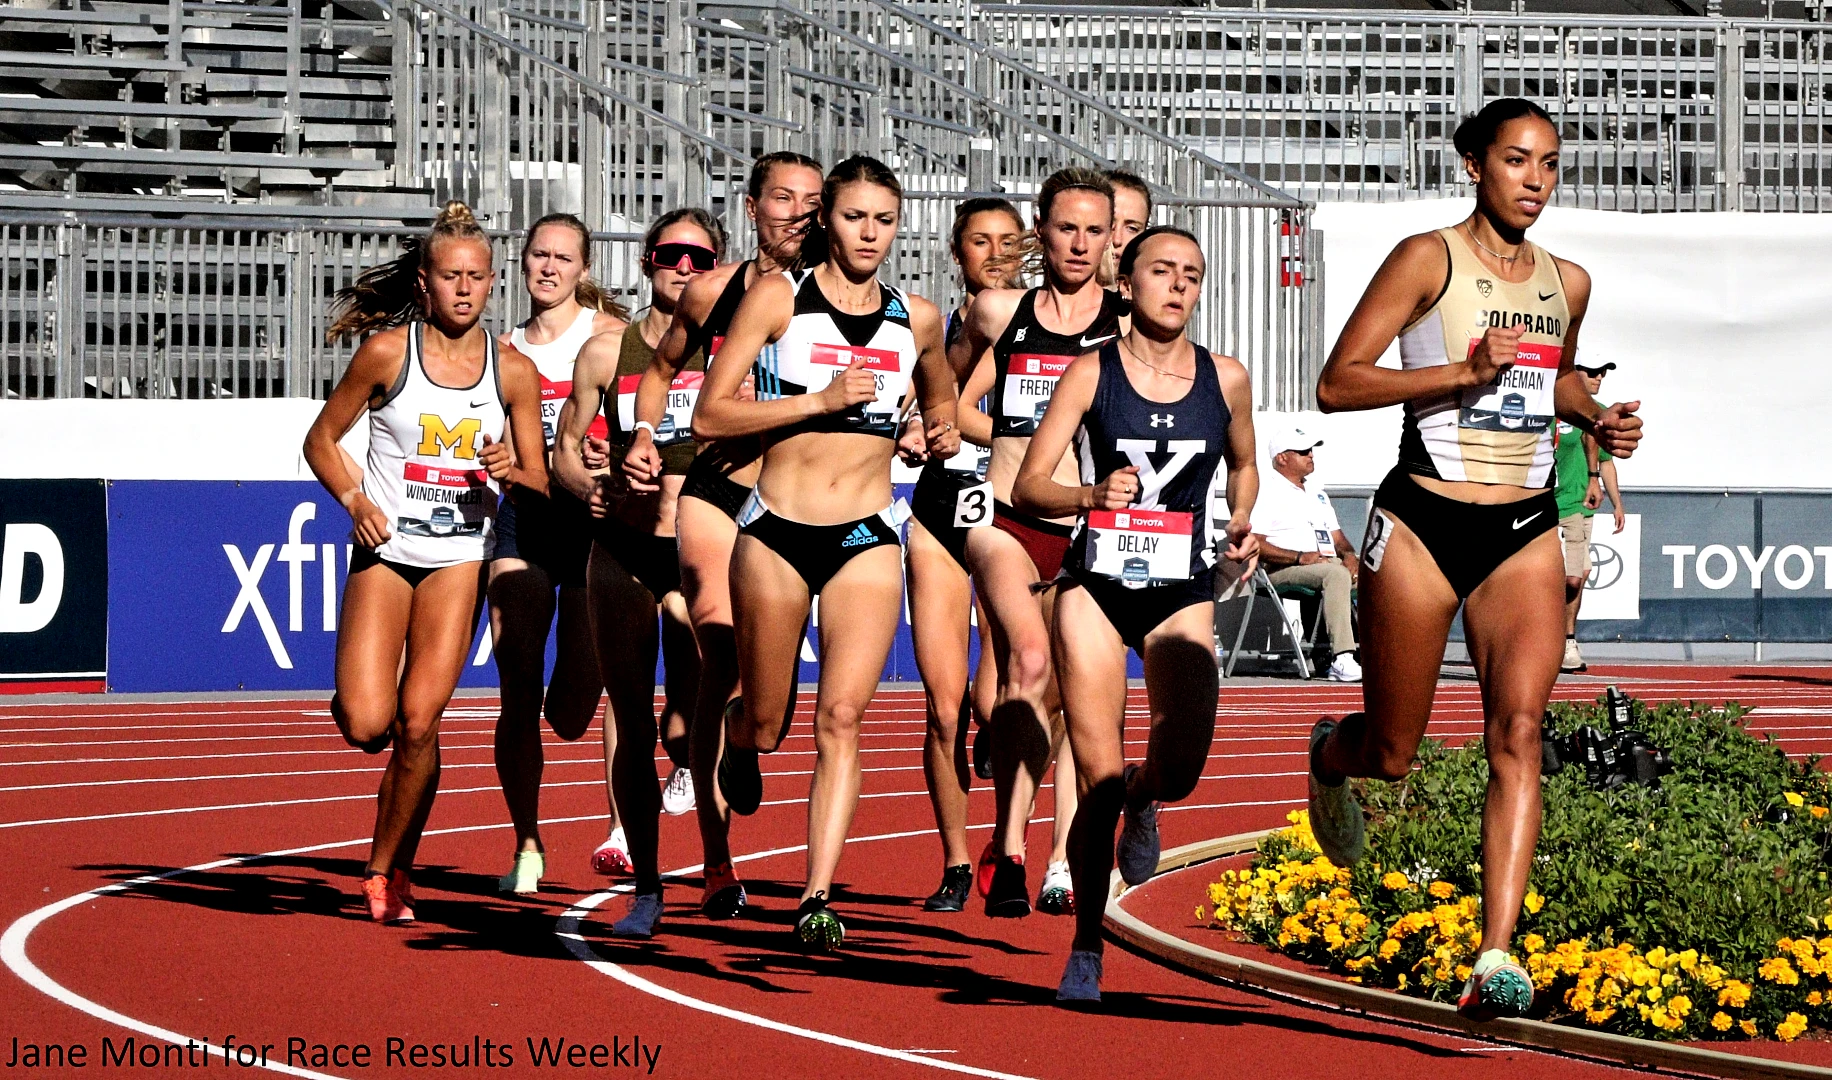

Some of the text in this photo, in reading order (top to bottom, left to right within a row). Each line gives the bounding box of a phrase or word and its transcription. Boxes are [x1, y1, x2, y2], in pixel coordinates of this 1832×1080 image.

[1475, 310, 1561, 338] COLORADO
[853, 354, 881, 364] TOOTA
[417, 412, 482, 461] M
[1116, 438, 1207, 512] Y
[406, 483, 483, 506] WINDEMULLER
[960, 490, 987, 524] 3
[1132, 517, 1164, 528] TOYOTA
[841, 535, 879, 547] adidas
[1117, 534, 1160, 554] DELAY
[1364, 515, 1385, 567] 2
[221, 501, 353, 669] xfi
